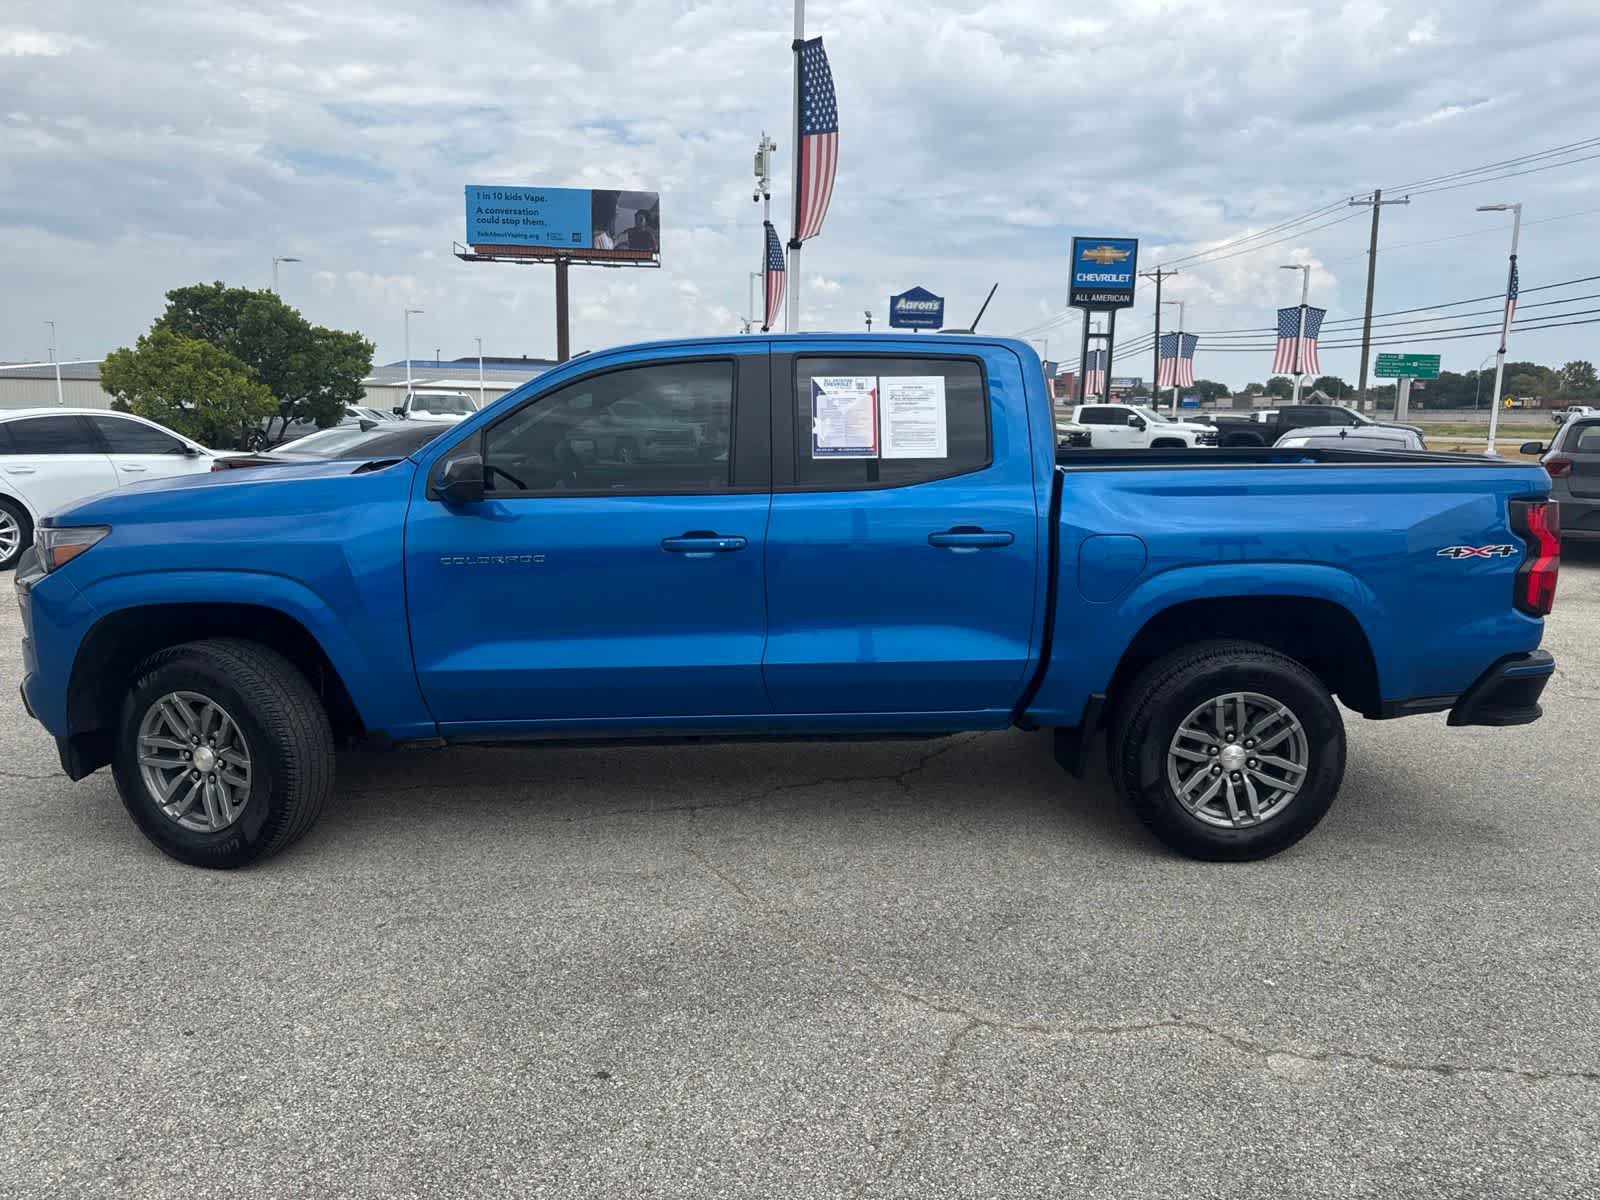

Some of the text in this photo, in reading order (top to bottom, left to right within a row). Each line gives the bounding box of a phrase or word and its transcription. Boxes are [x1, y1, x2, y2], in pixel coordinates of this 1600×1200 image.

[482, 192, 490, 200] in
[493, 192, 503, 201] 10
[504, 192, 522, 201] kids
[523, 193, 548, 204] Vape.
[476, 206, 540, 216] A conversation
[476, 216, 548, 228] could stop them.
[1076, 273, 1131, 283] CHEVROLET
[1074, 293, 1130, 303] ALL AMERICAN
[896, 297, 940, 311] Aaron's
[440, 555, 545, 565] COLORADO
